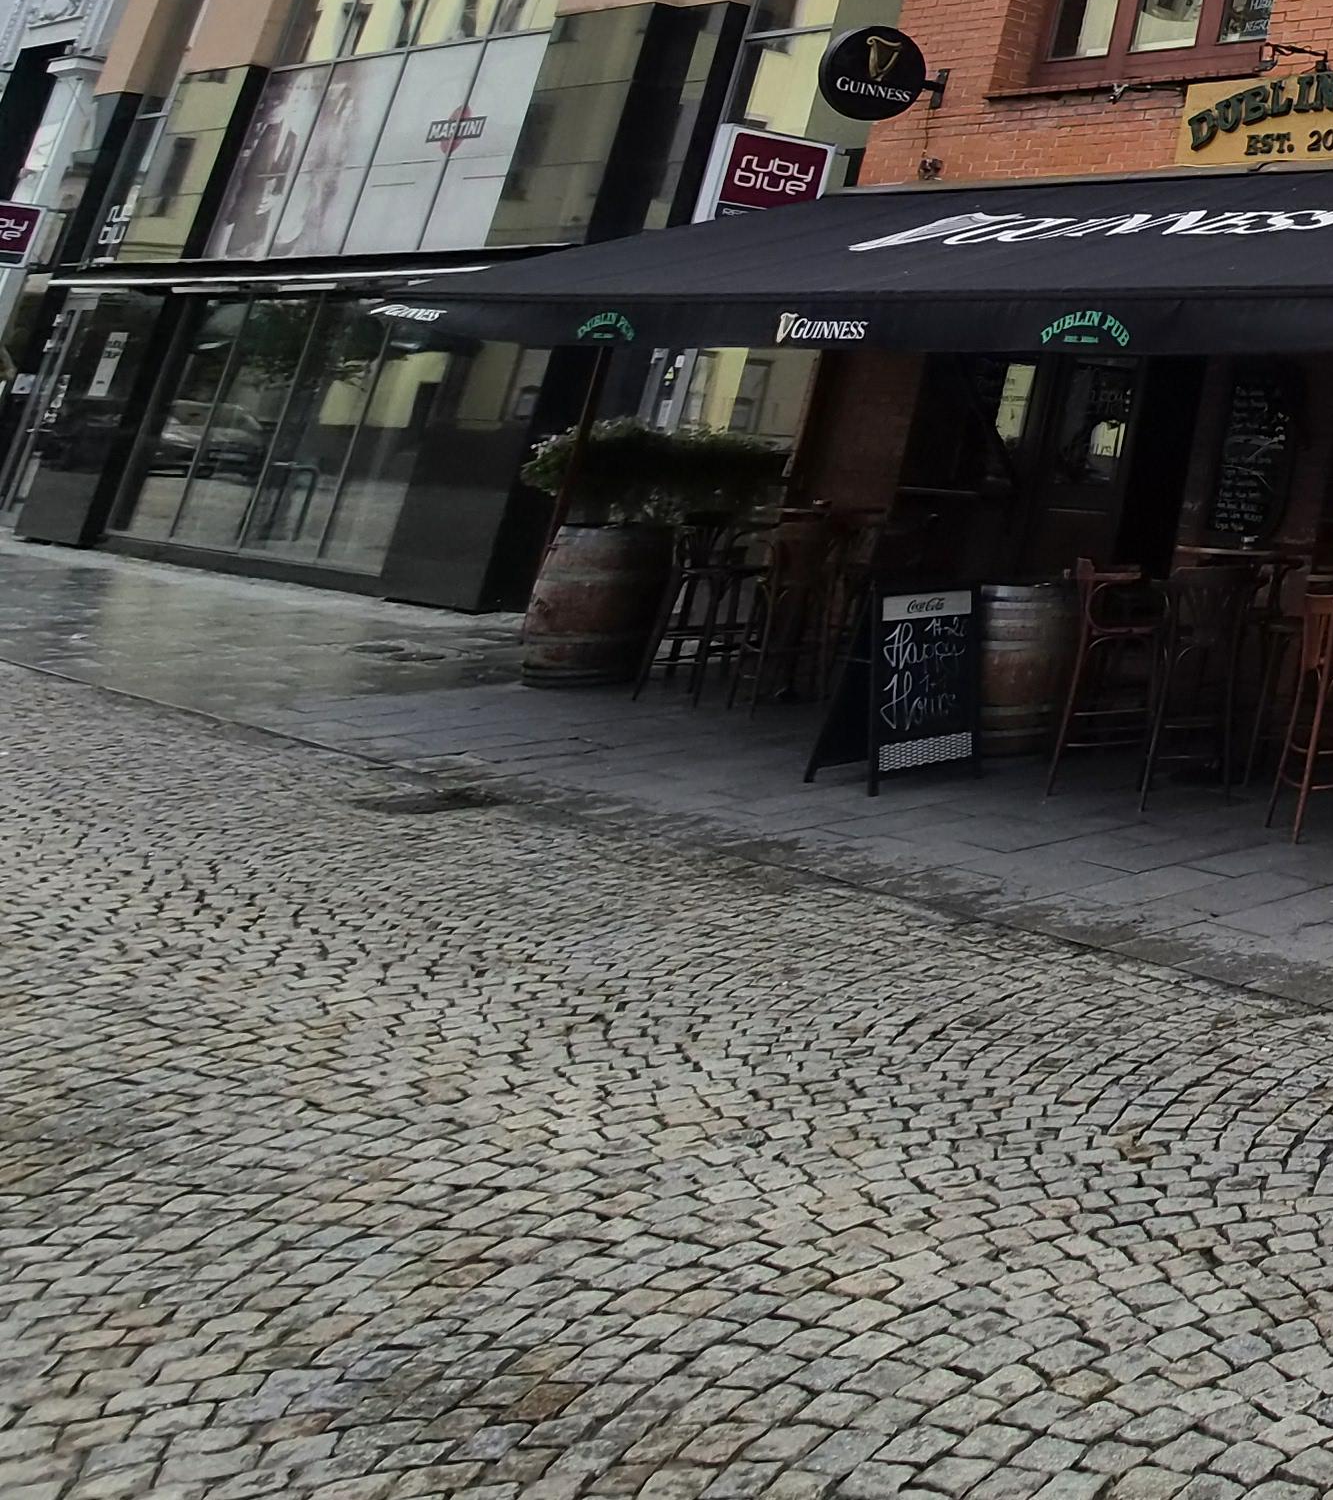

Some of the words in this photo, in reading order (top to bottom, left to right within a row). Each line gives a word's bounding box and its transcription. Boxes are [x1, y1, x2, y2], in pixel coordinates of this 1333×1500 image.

[836, 76, 911, 103] GUINNESS
[428, 118, 484, 139] MARTINI
[1244, 132, 1295, 156] EST.
[733, 168, 808, 196] blue
[740, 154, 815, 183] ruby
[791, 317, 868, 340] GUINNESS
[1040, 310, 1103, 345] DUBLIN
[1102, 314, 1130, 347] PUB
